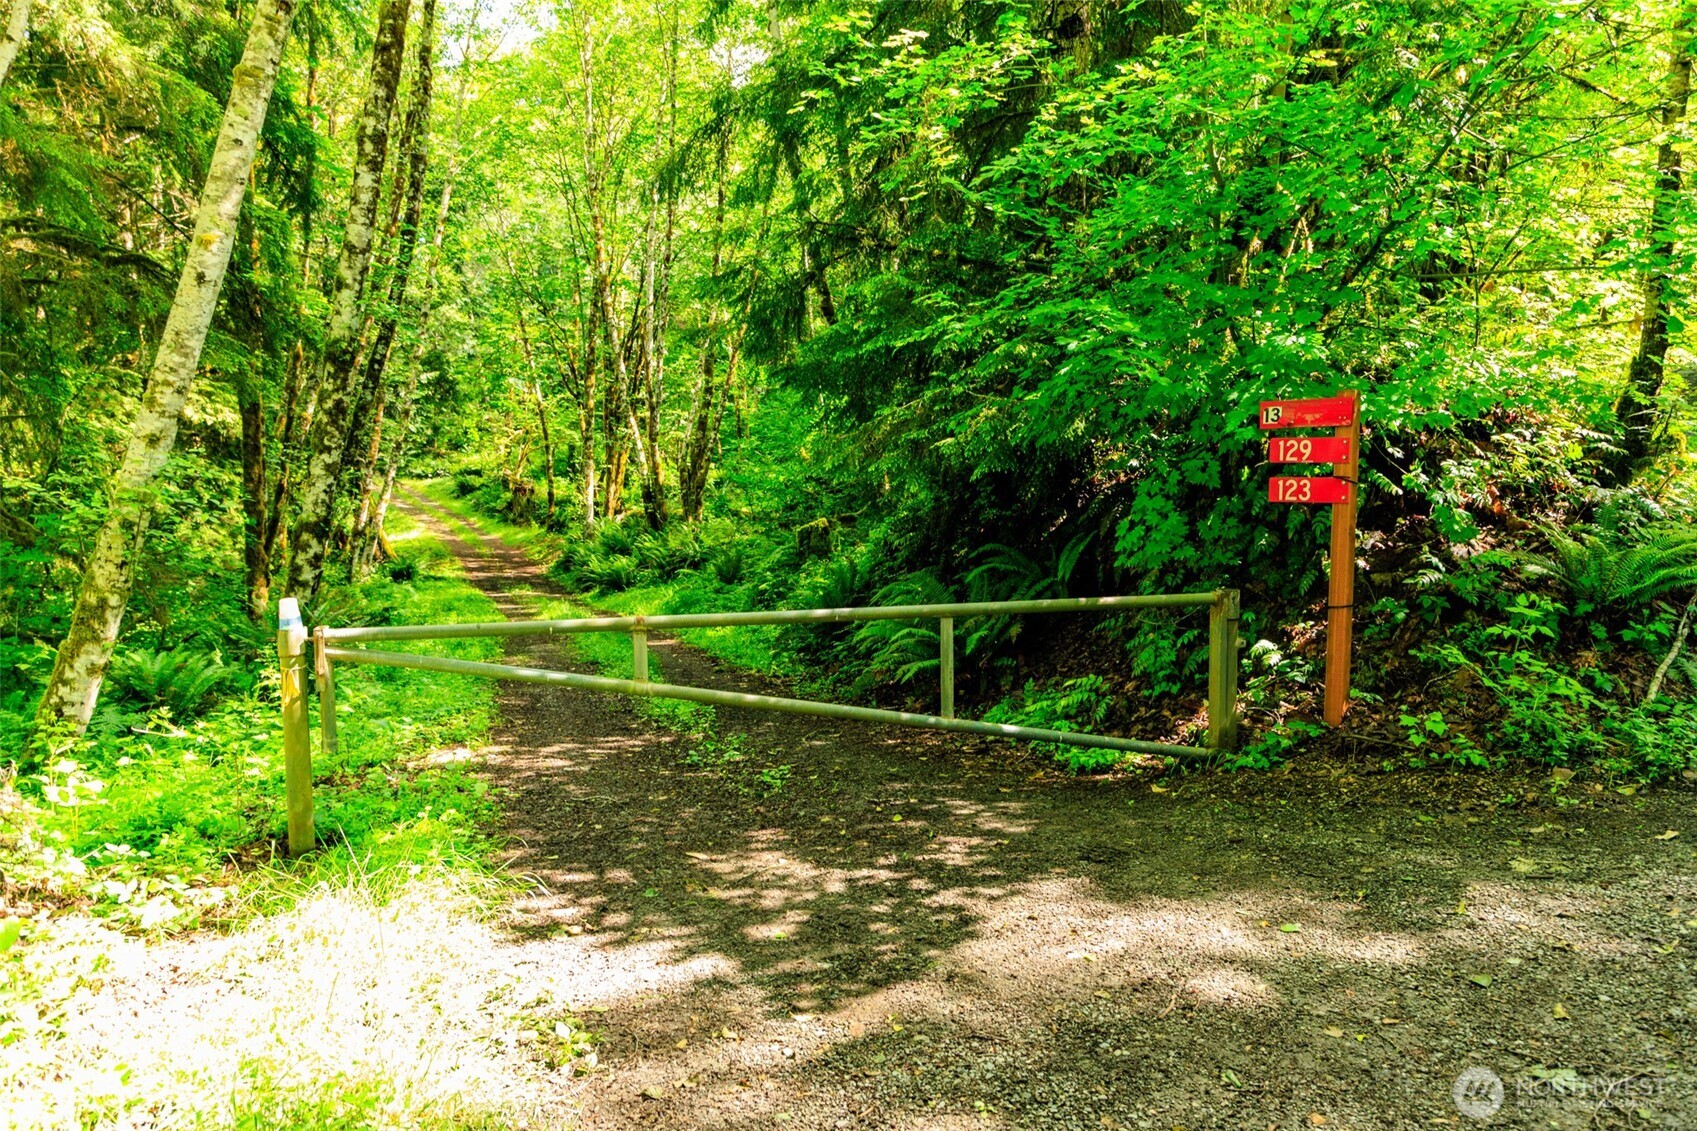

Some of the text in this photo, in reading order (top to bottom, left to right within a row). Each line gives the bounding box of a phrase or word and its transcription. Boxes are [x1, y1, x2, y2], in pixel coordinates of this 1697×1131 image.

[1264, 407, 1281, 422] 13
[1278, 439, 1312, 462] 129
[1278, 479, 1311, 501] 123
